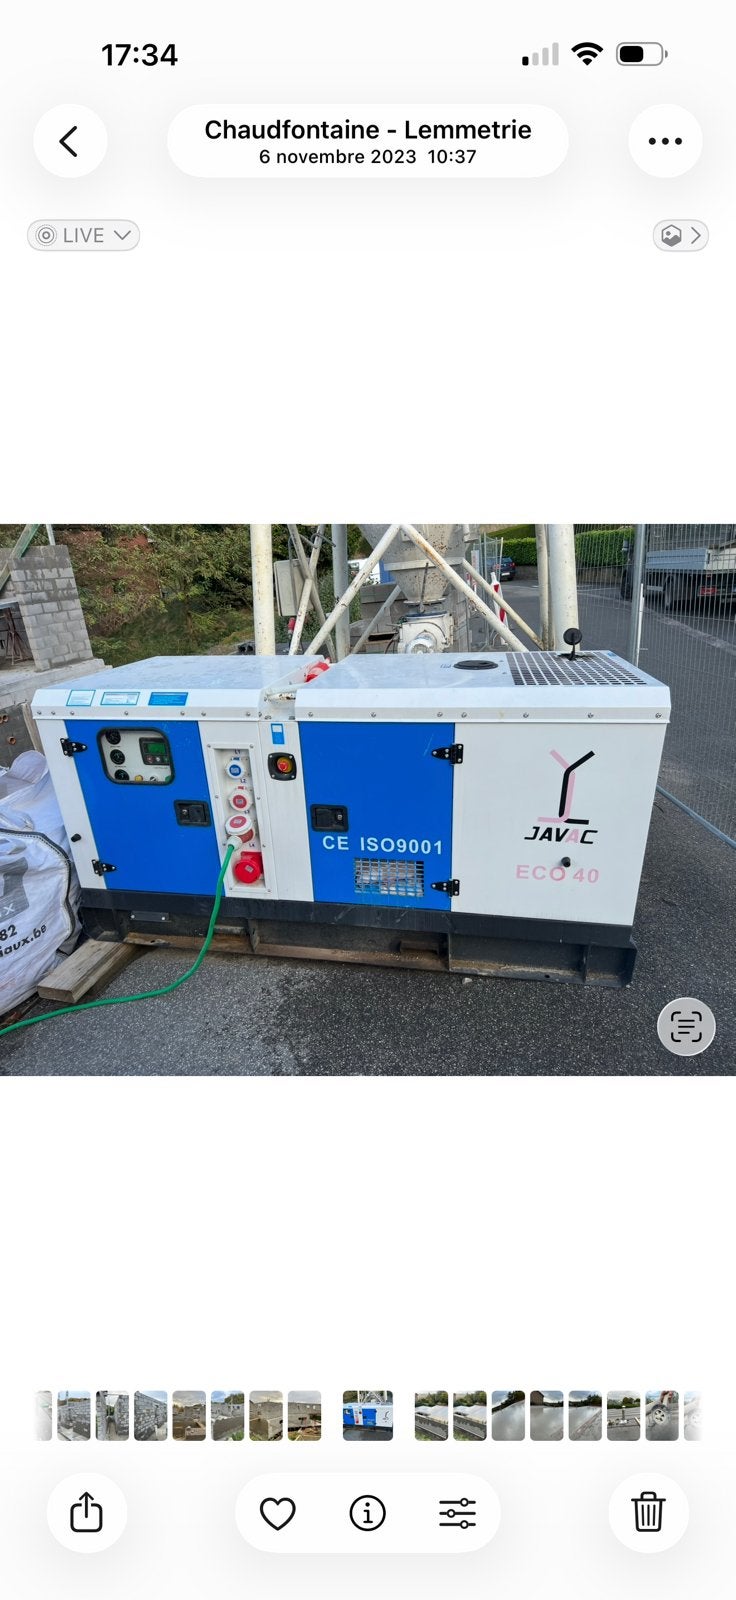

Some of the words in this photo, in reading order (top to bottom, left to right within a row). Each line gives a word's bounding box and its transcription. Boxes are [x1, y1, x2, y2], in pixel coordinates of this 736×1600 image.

[322, 835, 350, 851] CE
[360, 837, 442, 855] ISO9001
[523, 826, 599, 845] JAVAC
[515, 864, 566, 882] ECO
[572, 867, 600, 884] 40
